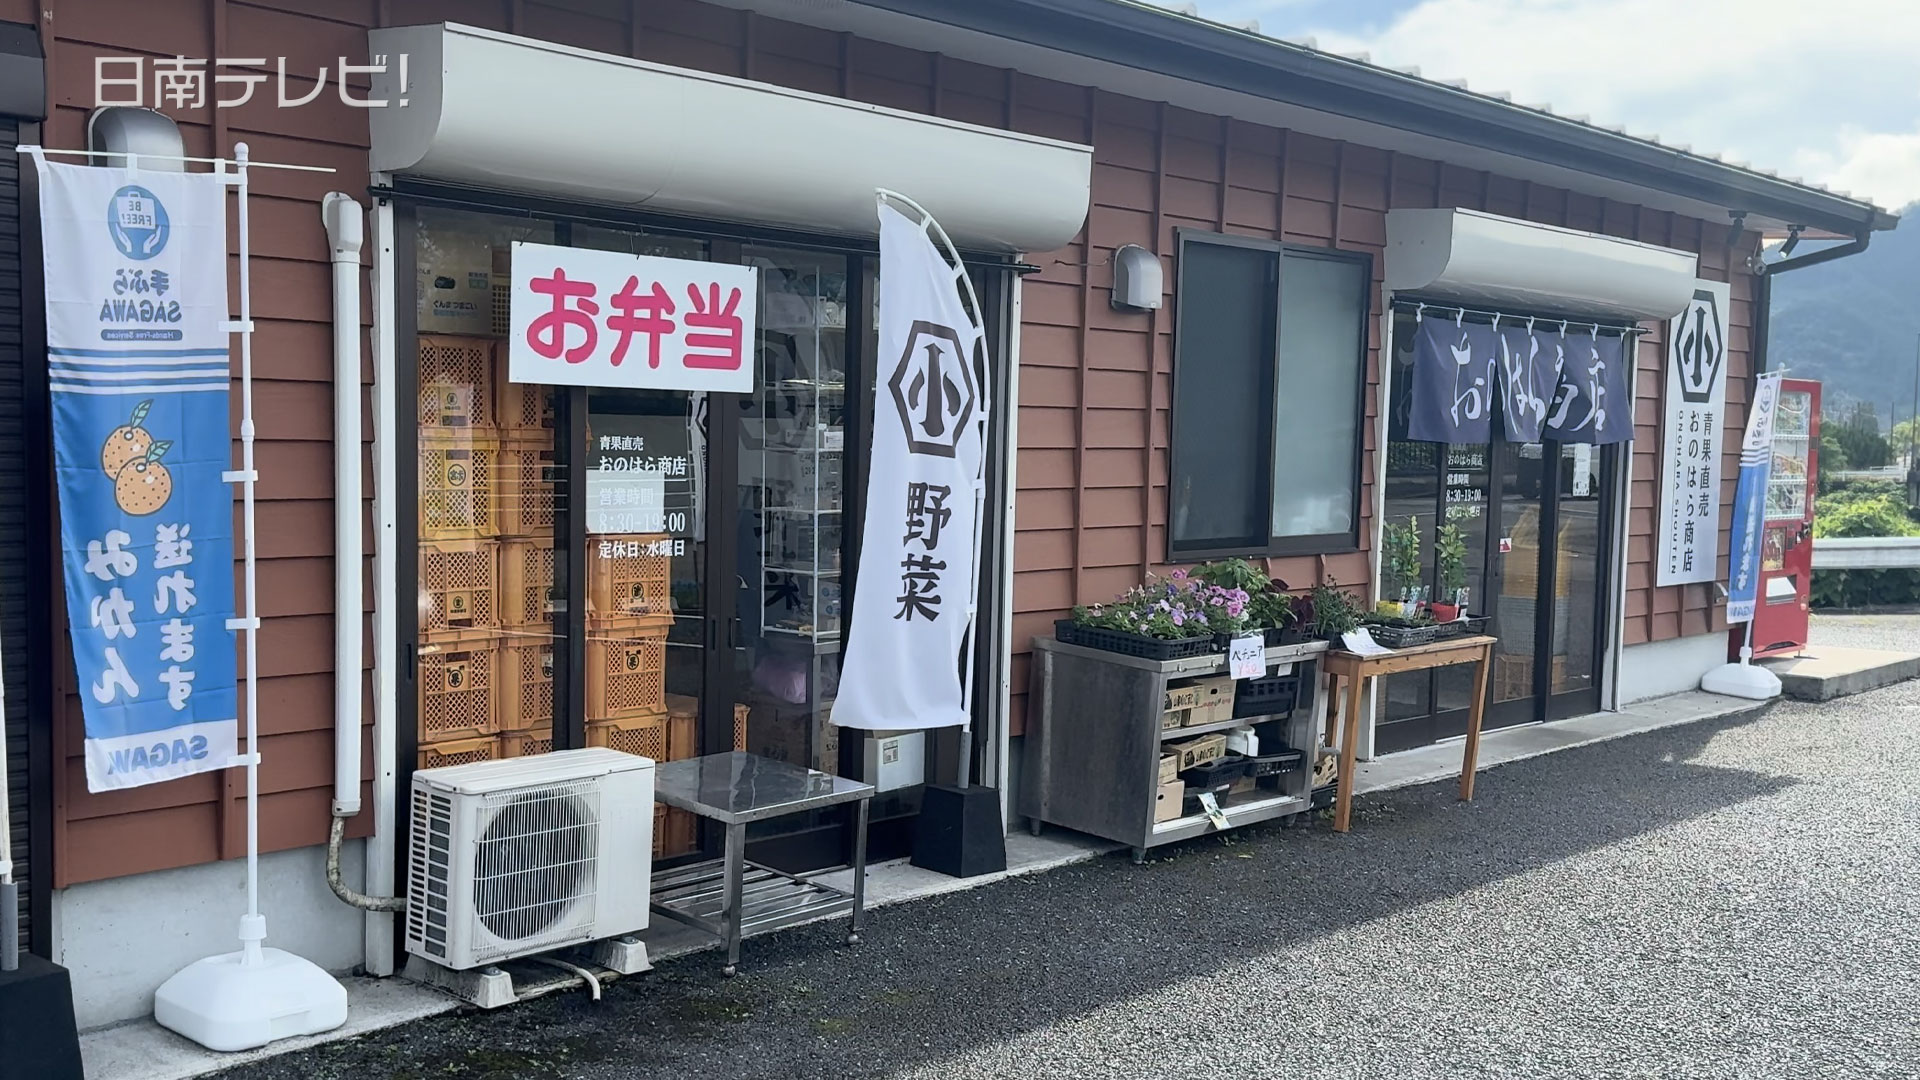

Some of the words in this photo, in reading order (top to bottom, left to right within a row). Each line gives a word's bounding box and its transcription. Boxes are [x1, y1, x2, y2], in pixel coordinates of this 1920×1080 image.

[526, 267, 743, 370] お弁当
[908, 342, 961, 437] 小
[600, 435, 644, 451] 青果直売
[600, 455, 687, 476] おのはら商店
[1675, 410, 1684, 490] ONOHARA
[1699, 411, 1713, 517] 青果直売
[600, 487, 654, 506] 営業時間
[1683, 410, 1700, 572] おのはら商店
[893, 481, 952, 622] 野菜
[1671, 499, 1679, 574] SHOUTEN
